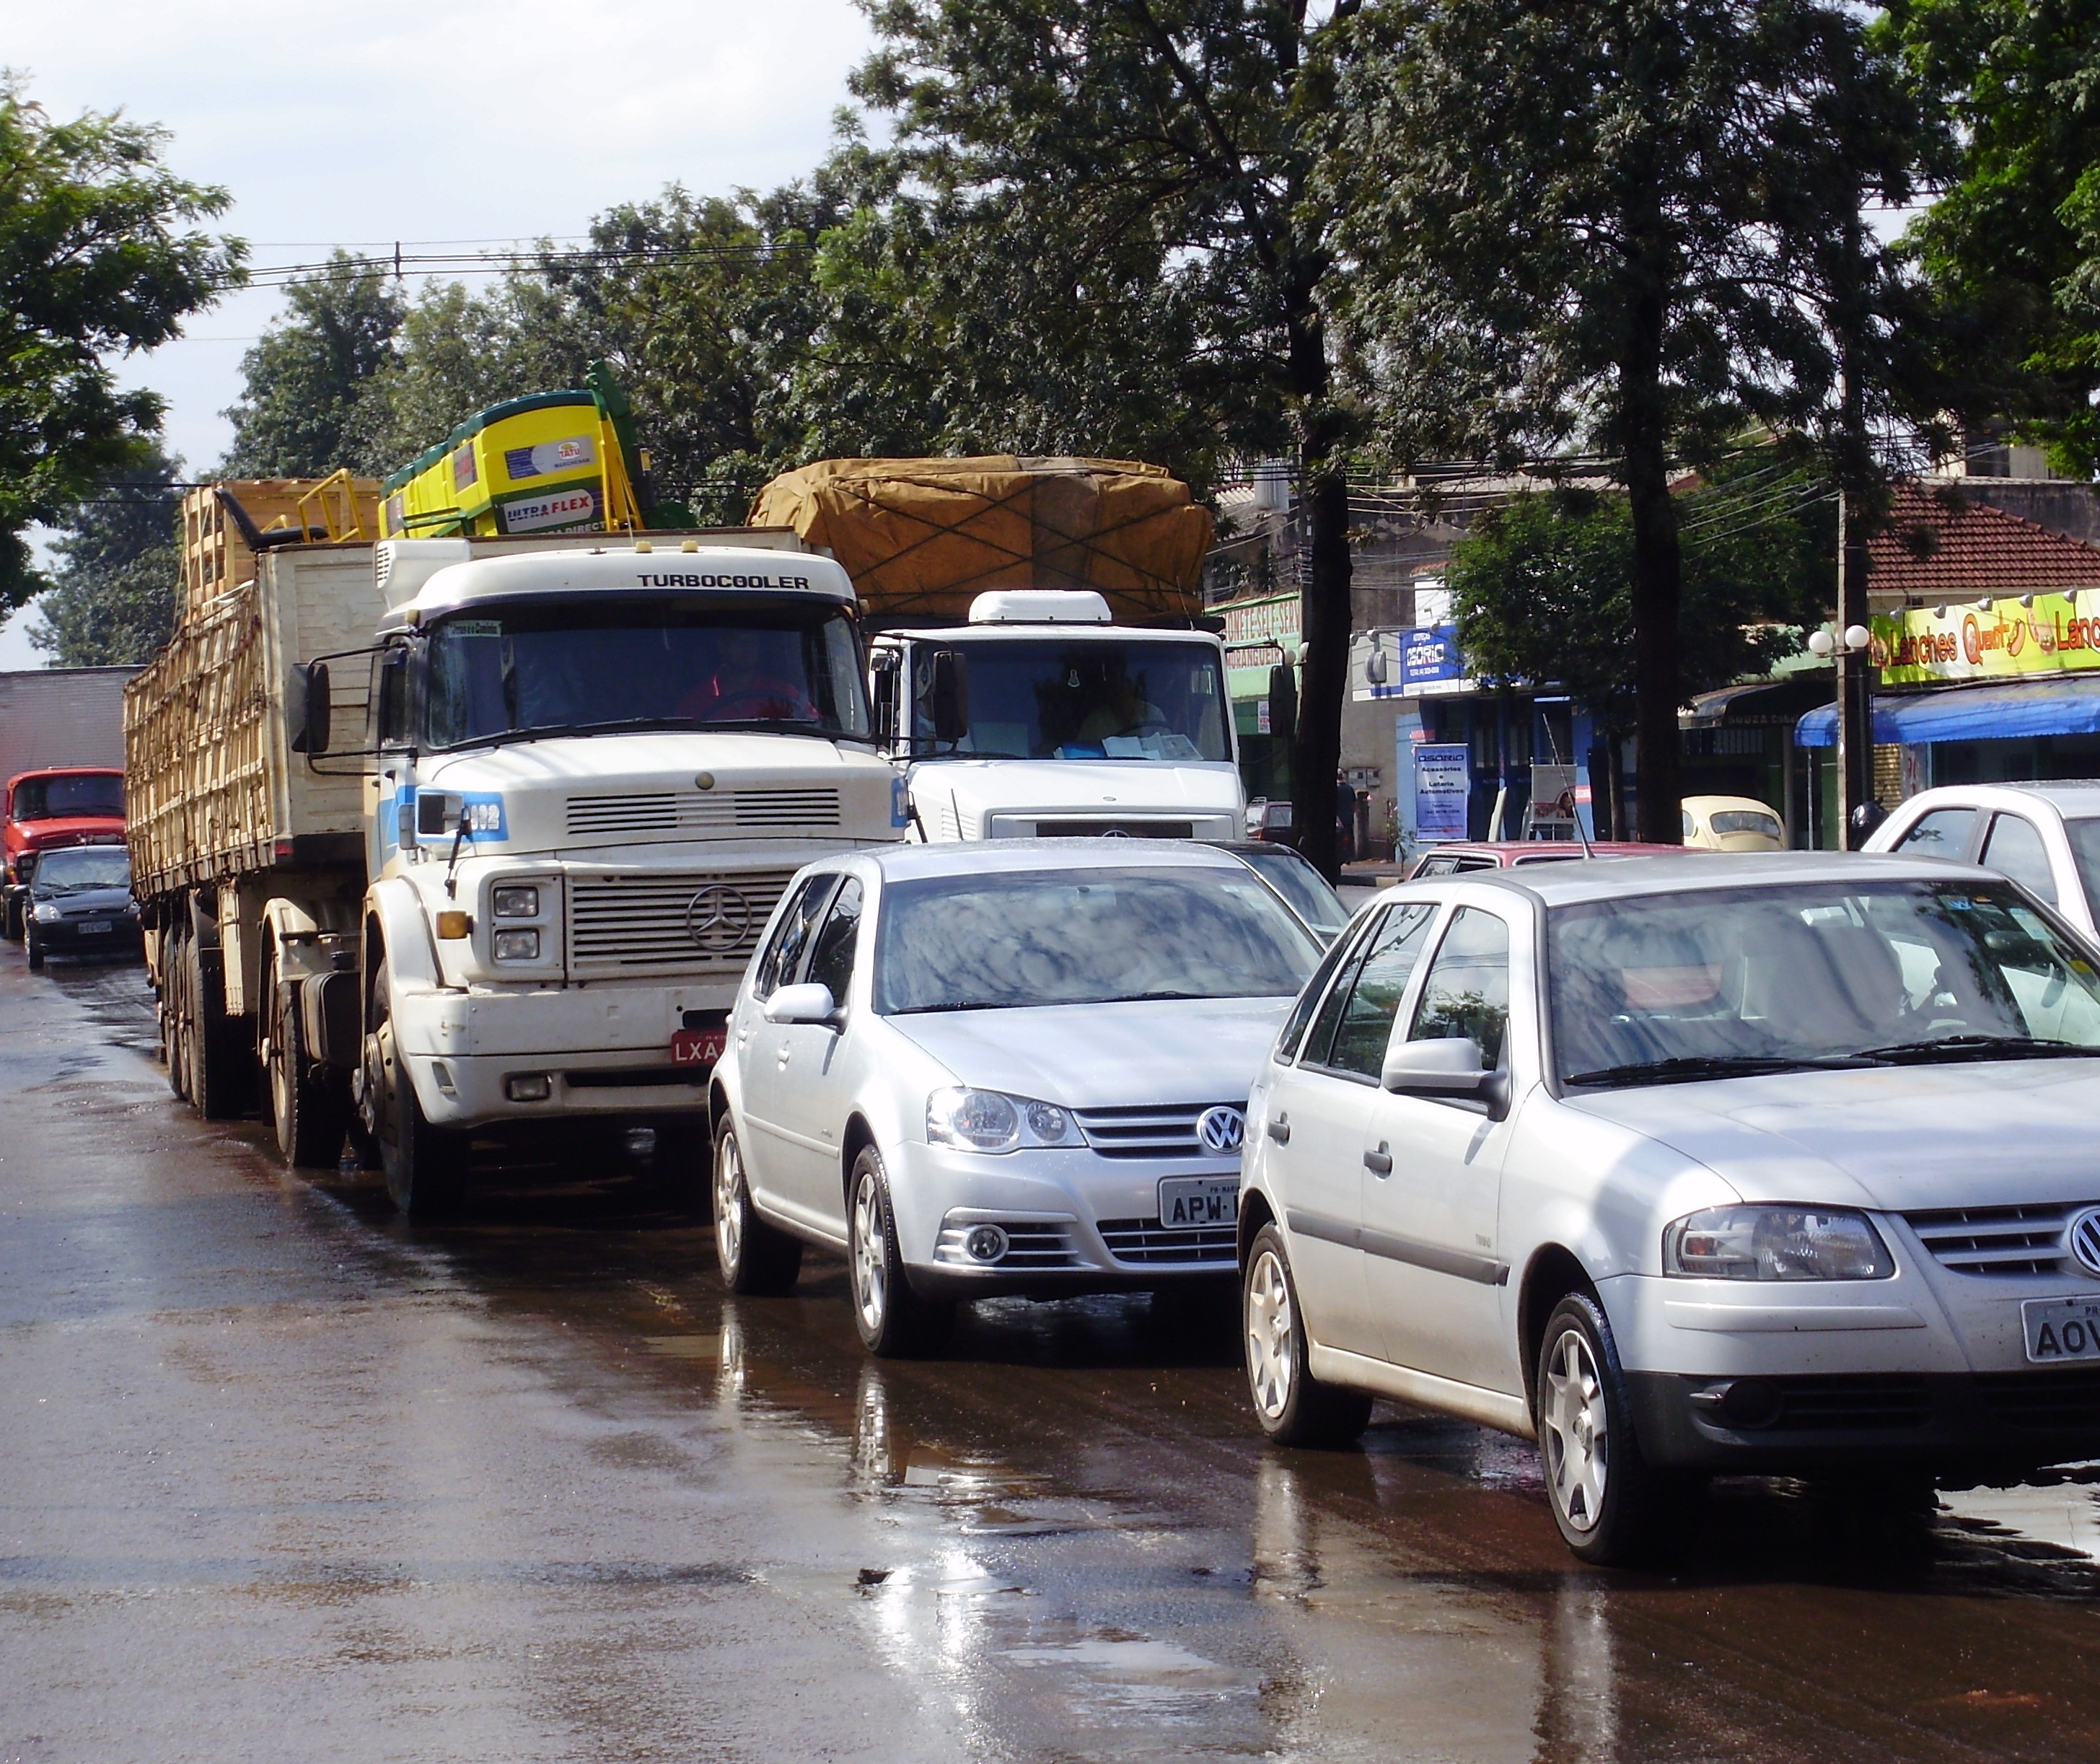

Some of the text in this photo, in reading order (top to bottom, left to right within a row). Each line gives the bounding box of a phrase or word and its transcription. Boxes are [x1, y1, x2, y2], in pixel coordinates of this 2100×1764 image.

[558, 448, 580, 459] TATU
[637, 574, 810, 589] TURBOCOOLER
[1890, 626, 1958, 666] Lanches
[1226, 649, 1282, 668] MORANGUEIR
